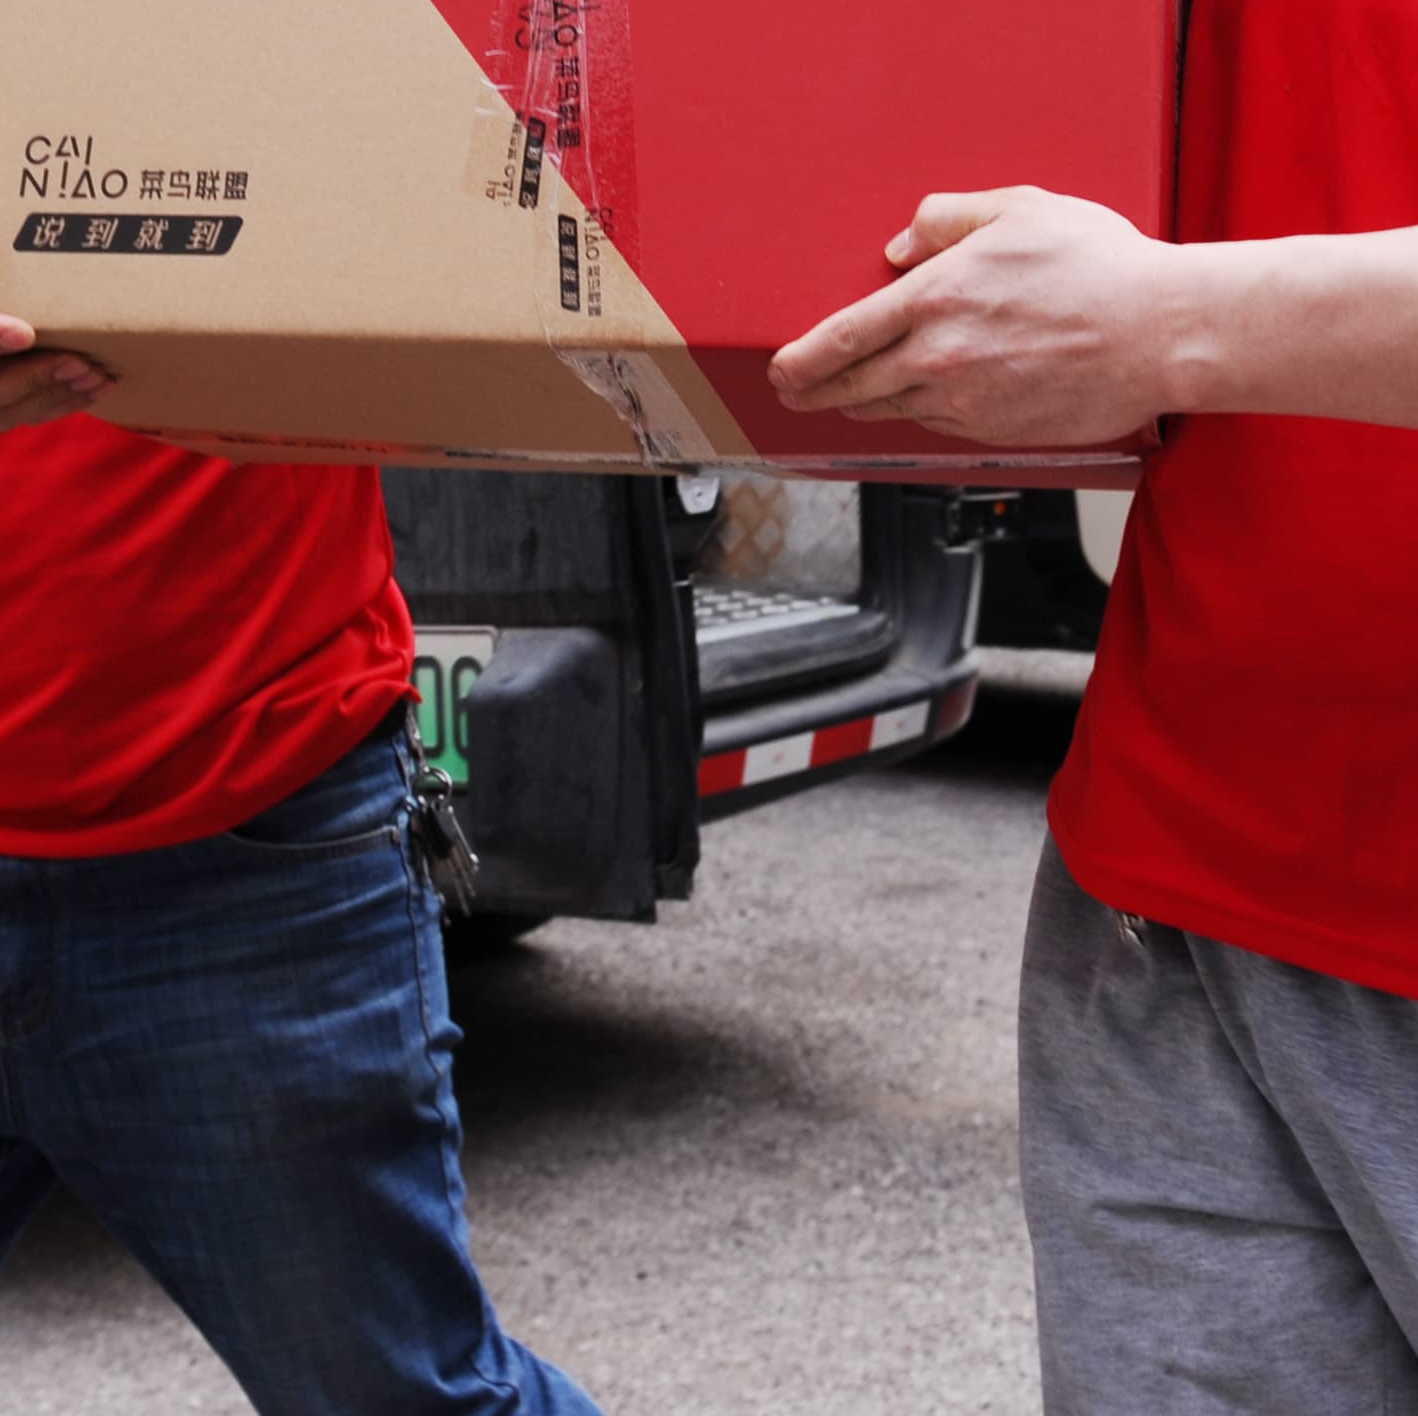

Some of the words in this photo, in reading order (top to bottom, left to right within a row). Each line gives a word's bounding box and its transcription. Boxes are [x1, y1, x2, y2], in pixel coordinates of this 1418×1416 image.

[25, 135, 93, 166] CAI
[139, 169, 249, 201] 菜鸟联盟
[32, 216, 224, 251] 说到就到
